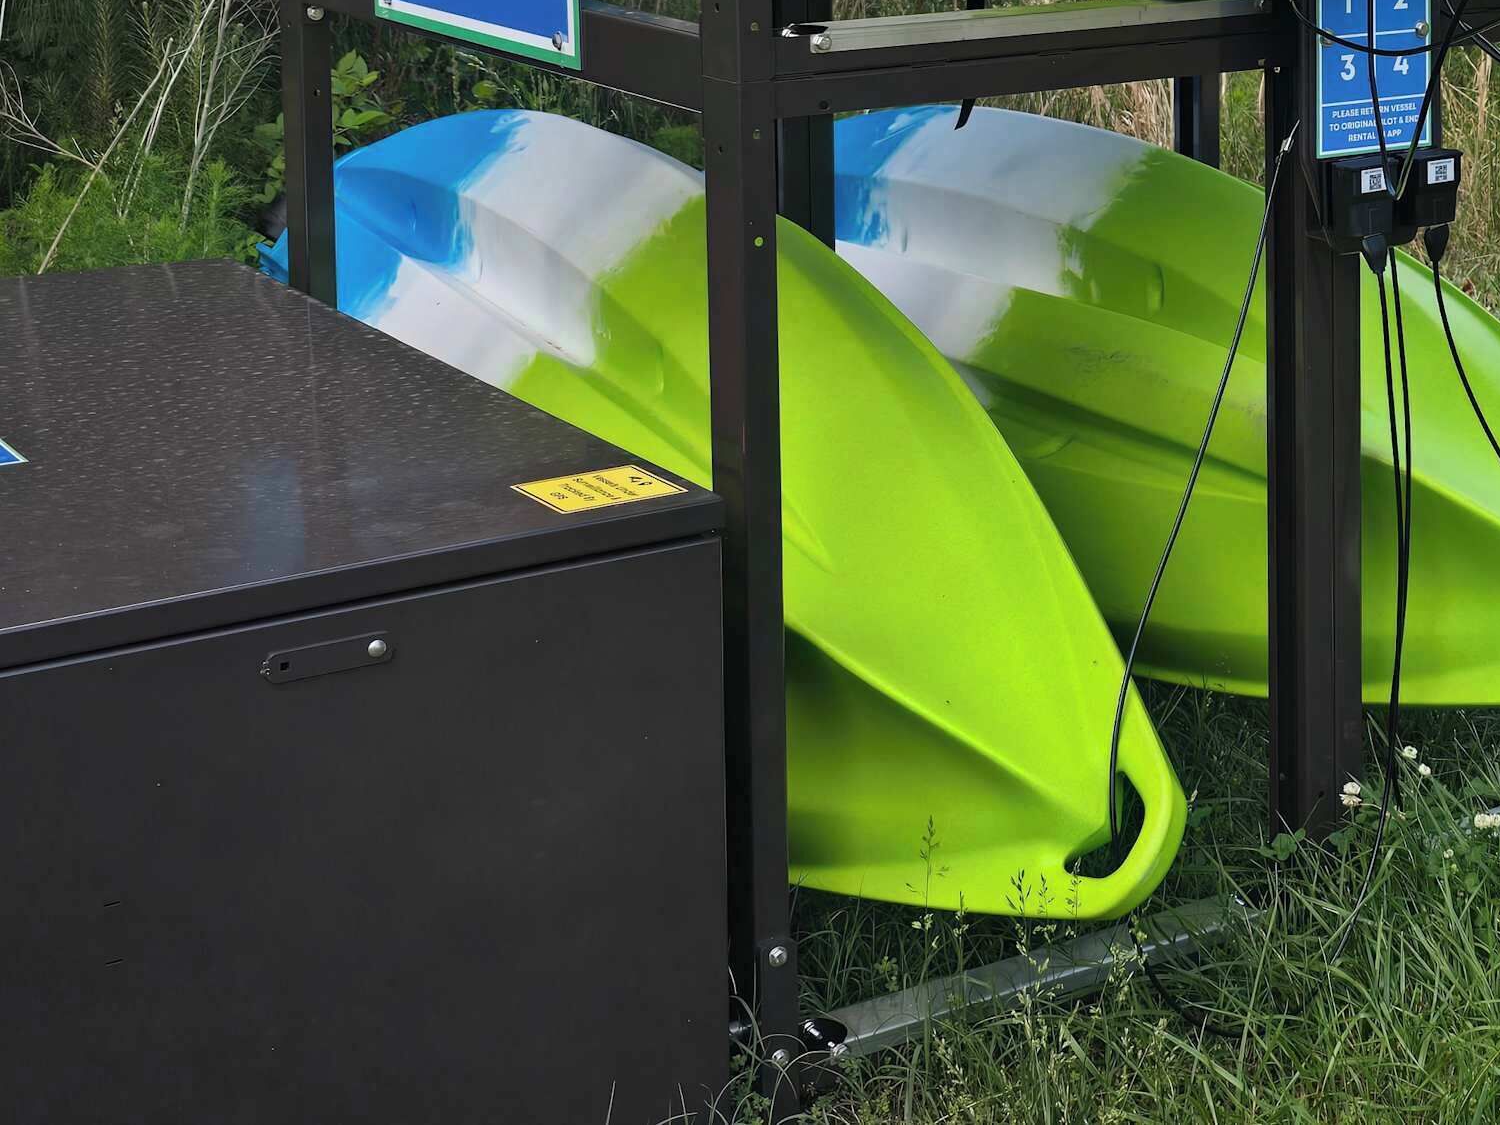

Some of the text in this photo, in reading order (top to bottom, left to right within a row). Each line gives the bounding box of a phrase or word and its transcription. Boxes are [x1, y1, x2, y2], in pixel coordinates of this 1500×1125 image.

[1340, 52, 1409, 81] 3 4
[1332, 103, 1416, 118] PLEASE RETRN VESSEL
[1329, 123, 1340, 131] TO
[1348, 132, 1376, 142] RENTAL
[1387, 129, 1402, 137] APP
